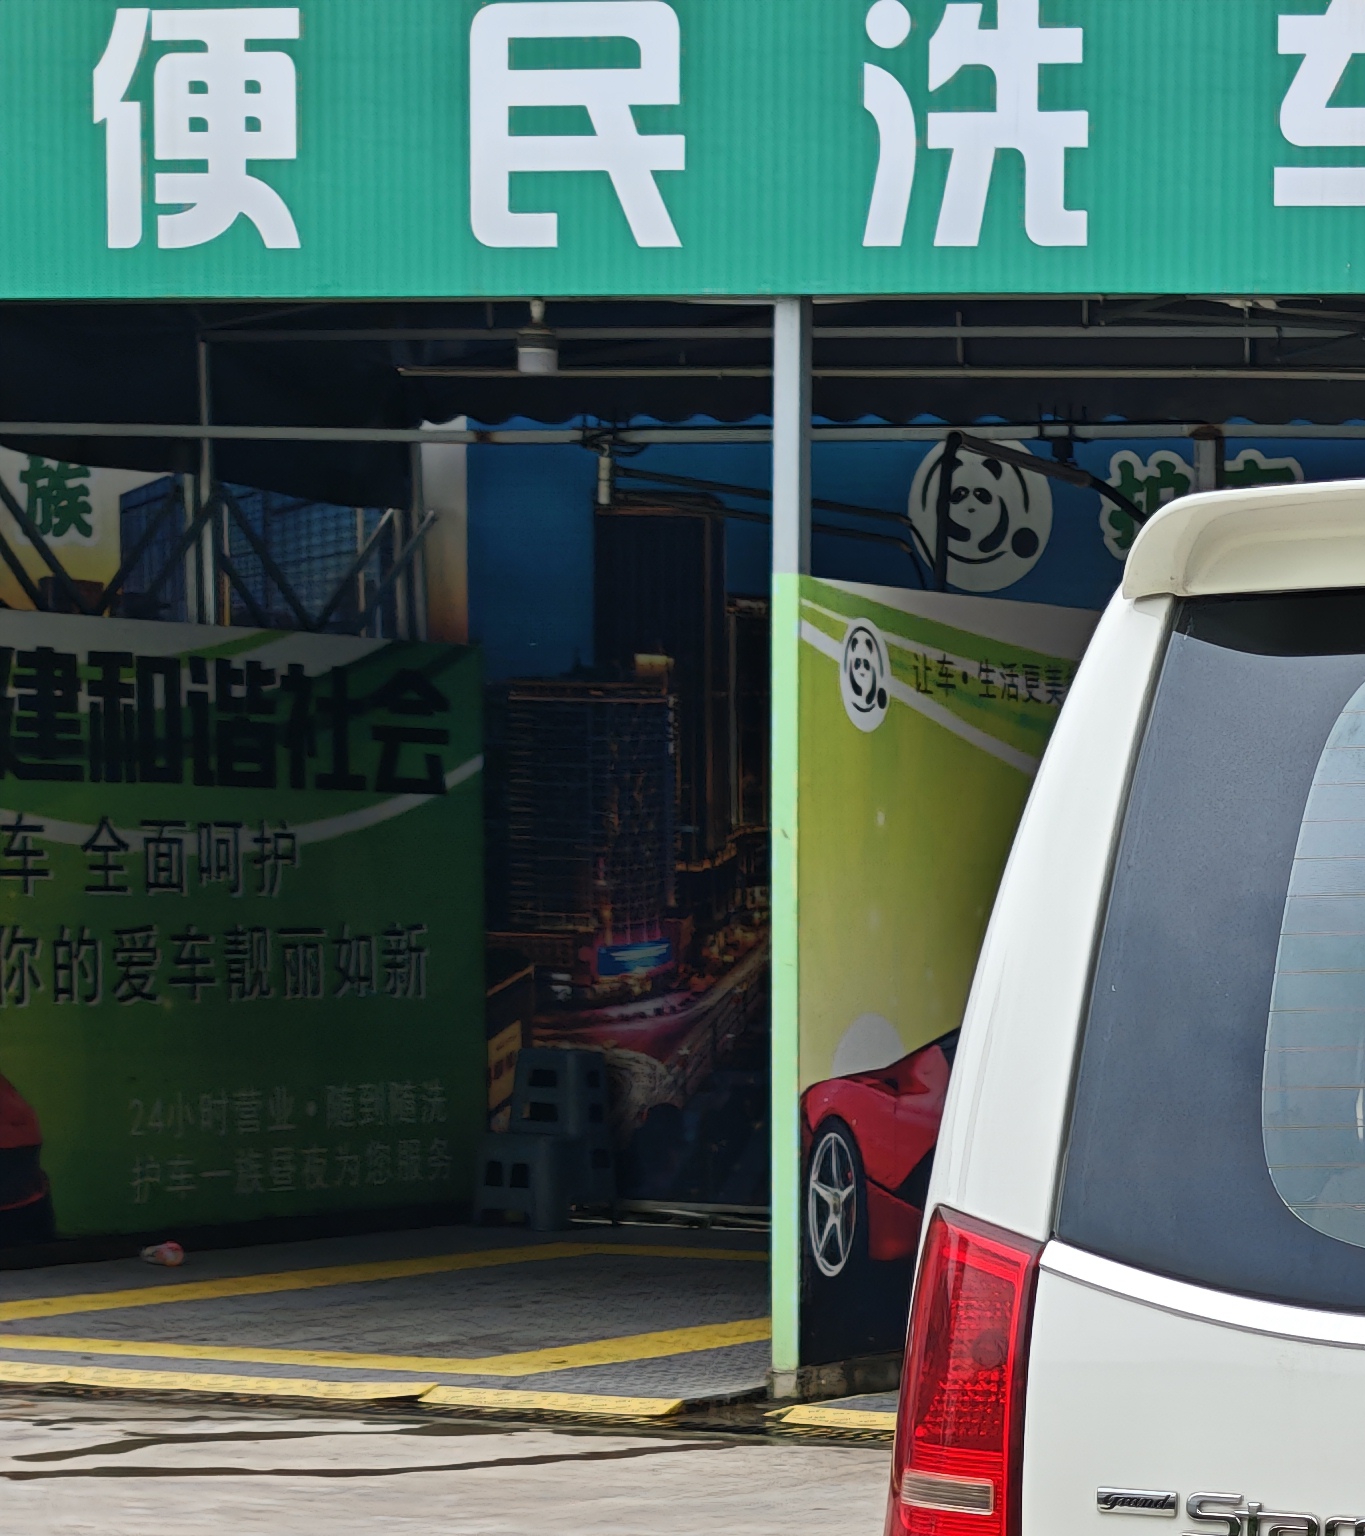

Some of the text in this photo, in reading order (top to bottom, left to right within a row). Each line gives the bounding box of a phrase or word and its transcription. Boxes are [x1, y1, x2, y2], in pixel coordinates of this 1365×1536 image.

[914, 653, 1075, 704] 让车·生活更美
[0, 647, 449, 794] 建和谐社会
[82, 815, 301, 898] 全面呵护
